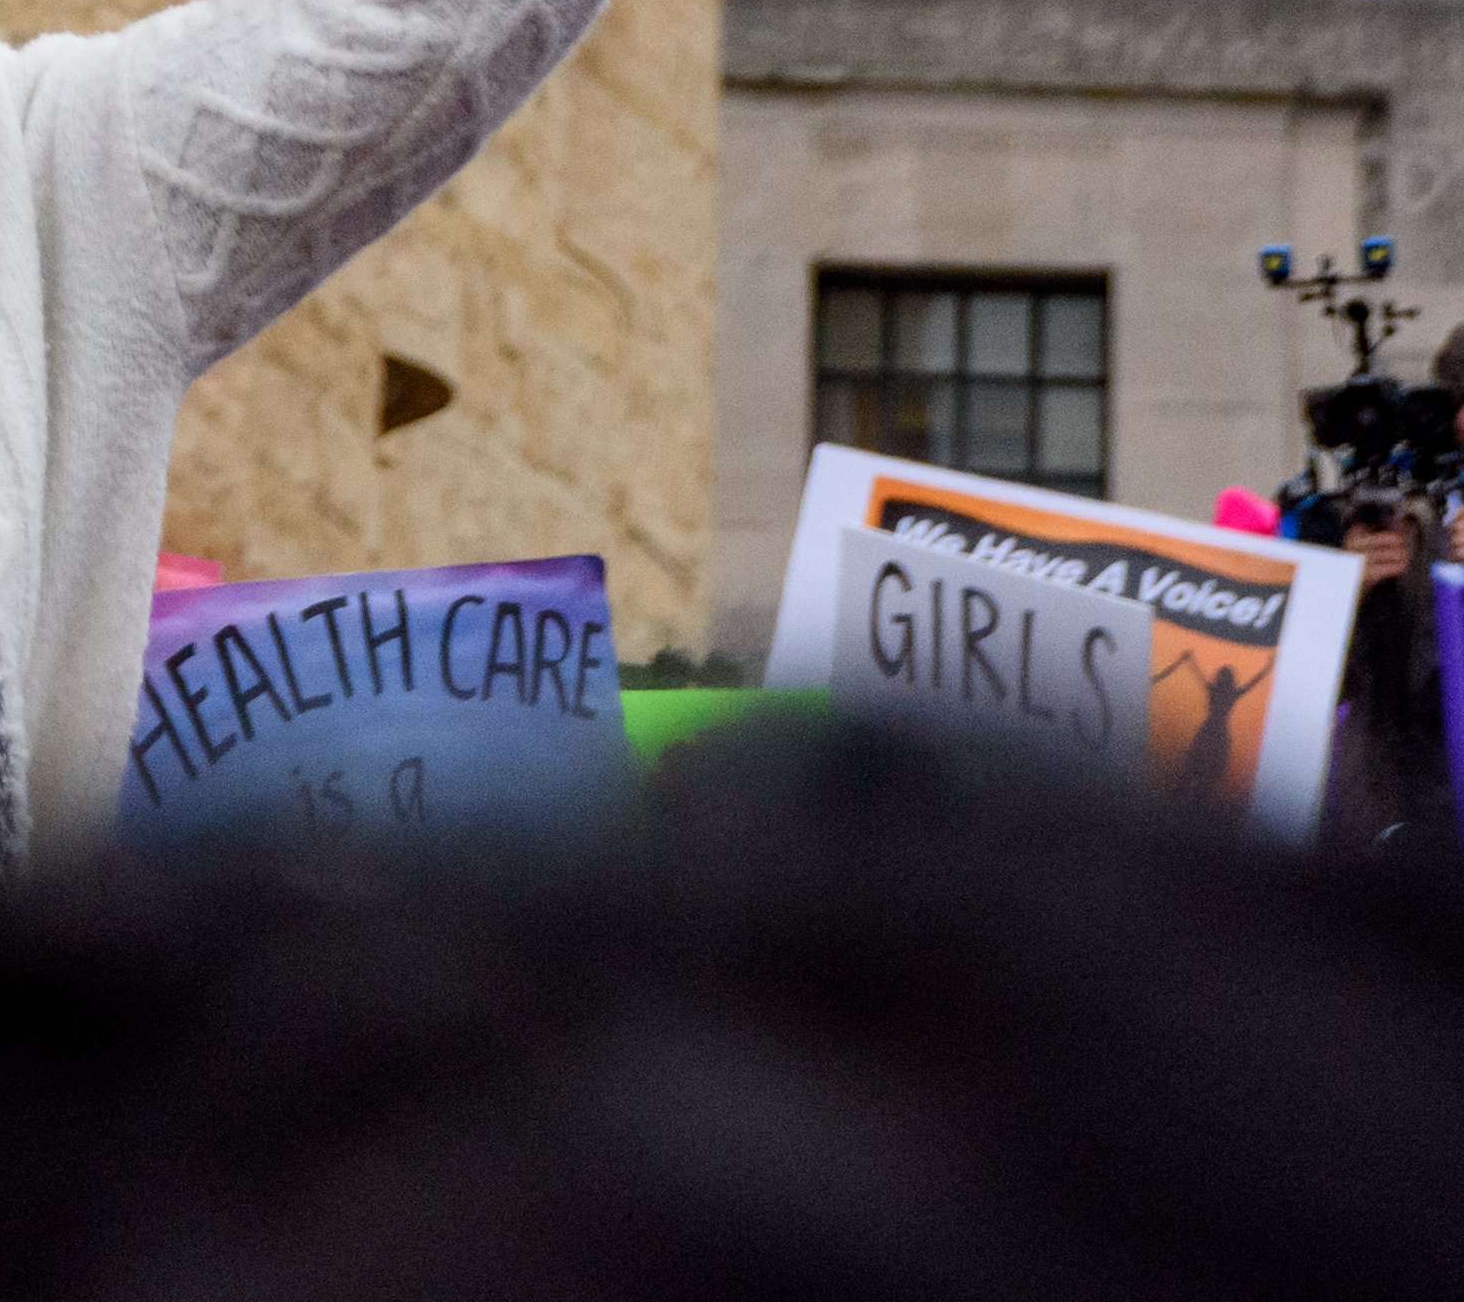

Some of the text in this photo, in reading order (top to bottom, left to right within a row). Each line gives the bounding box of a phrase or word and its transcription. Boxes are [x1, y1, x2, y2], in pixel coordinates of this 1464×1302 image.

[868, 559, 1118, 749] GIRLS
[970, 534, 1089, 587] Have
[1136, 565, 1284, 629] Voice!
[130, 589, 604, 809] HEALTH CARE
